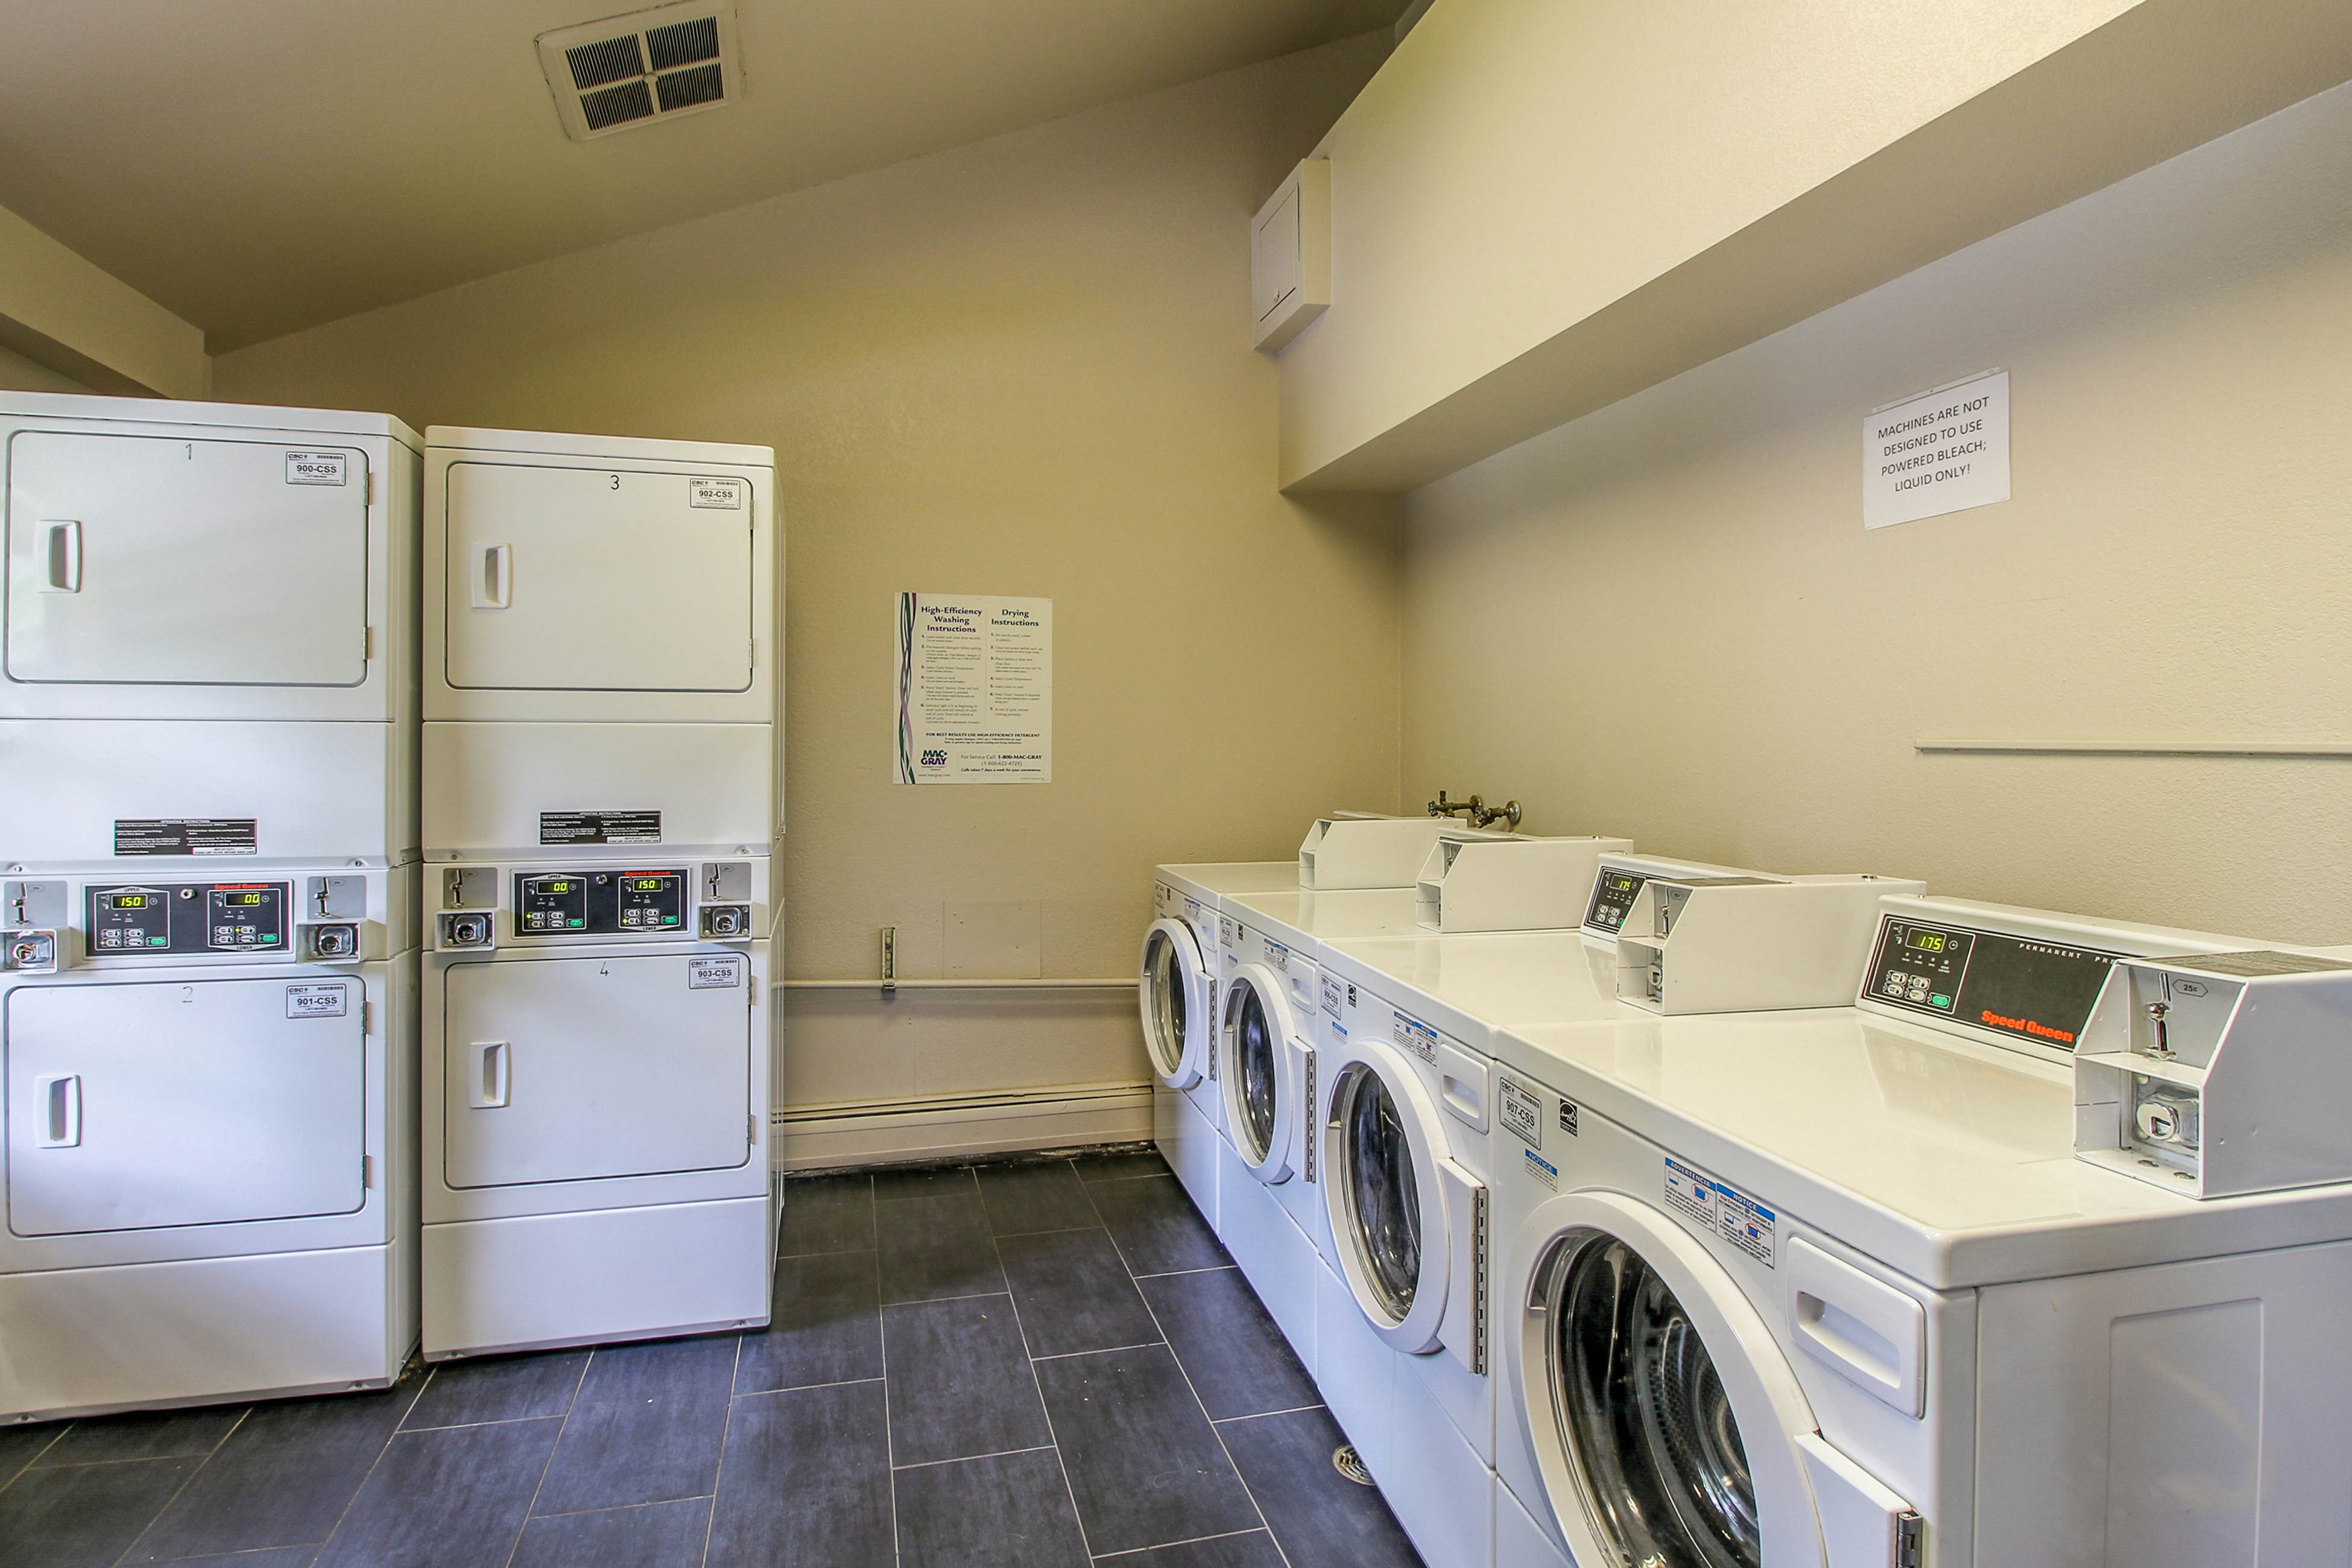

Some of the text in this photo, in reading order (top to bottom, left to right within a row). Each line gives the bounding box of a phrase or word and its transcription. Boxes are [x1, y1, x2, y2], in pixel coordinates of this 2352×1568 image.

[1878, 396, 1990, 439] MACHINES ARE NOT
[1884, 419, 1983, 457] DESIGNED TO USE
[185, 444, 191, 460] 1
[1882, 440, 1987, 476] POWERED BLEACH;
[297, 464, 337, 473] 900-CSS
[610, 475, 619, 490] 3
[1895, 464, 1970, 492] LIQUID ONLY!
[922, 606, 982, 616] High-Efficiency
[1002, 609, 1029, 618] Drying
[934, 616, 970, 625] Washing
[554, 883, 567, 891] 00
[639, 880, 656, 889] 150
[121, 897, 141, 906] 150
[244, 894, 260, 903] 00
[1920, 936, 1943, 950] 175
[2019, 943, 2081, 959] PERMANENT
[600, 961, 609, 976] 4
[698, 969, 732, 978] 903-CSS
[182, 986, 193, 1003] 2
[297, 997, 337, 1005] 901-CSS
[1981, 1010, 2075, 1043] Speed Queen
[1506, 1099, 1535, 1127] 907-CSS
[1529, 1152, 1554, 1173] NOTICE
[1670, 1162, 1711, 1187] ADVERTENCIA
[1733, 1193, 1757, 1212] NOTICE
